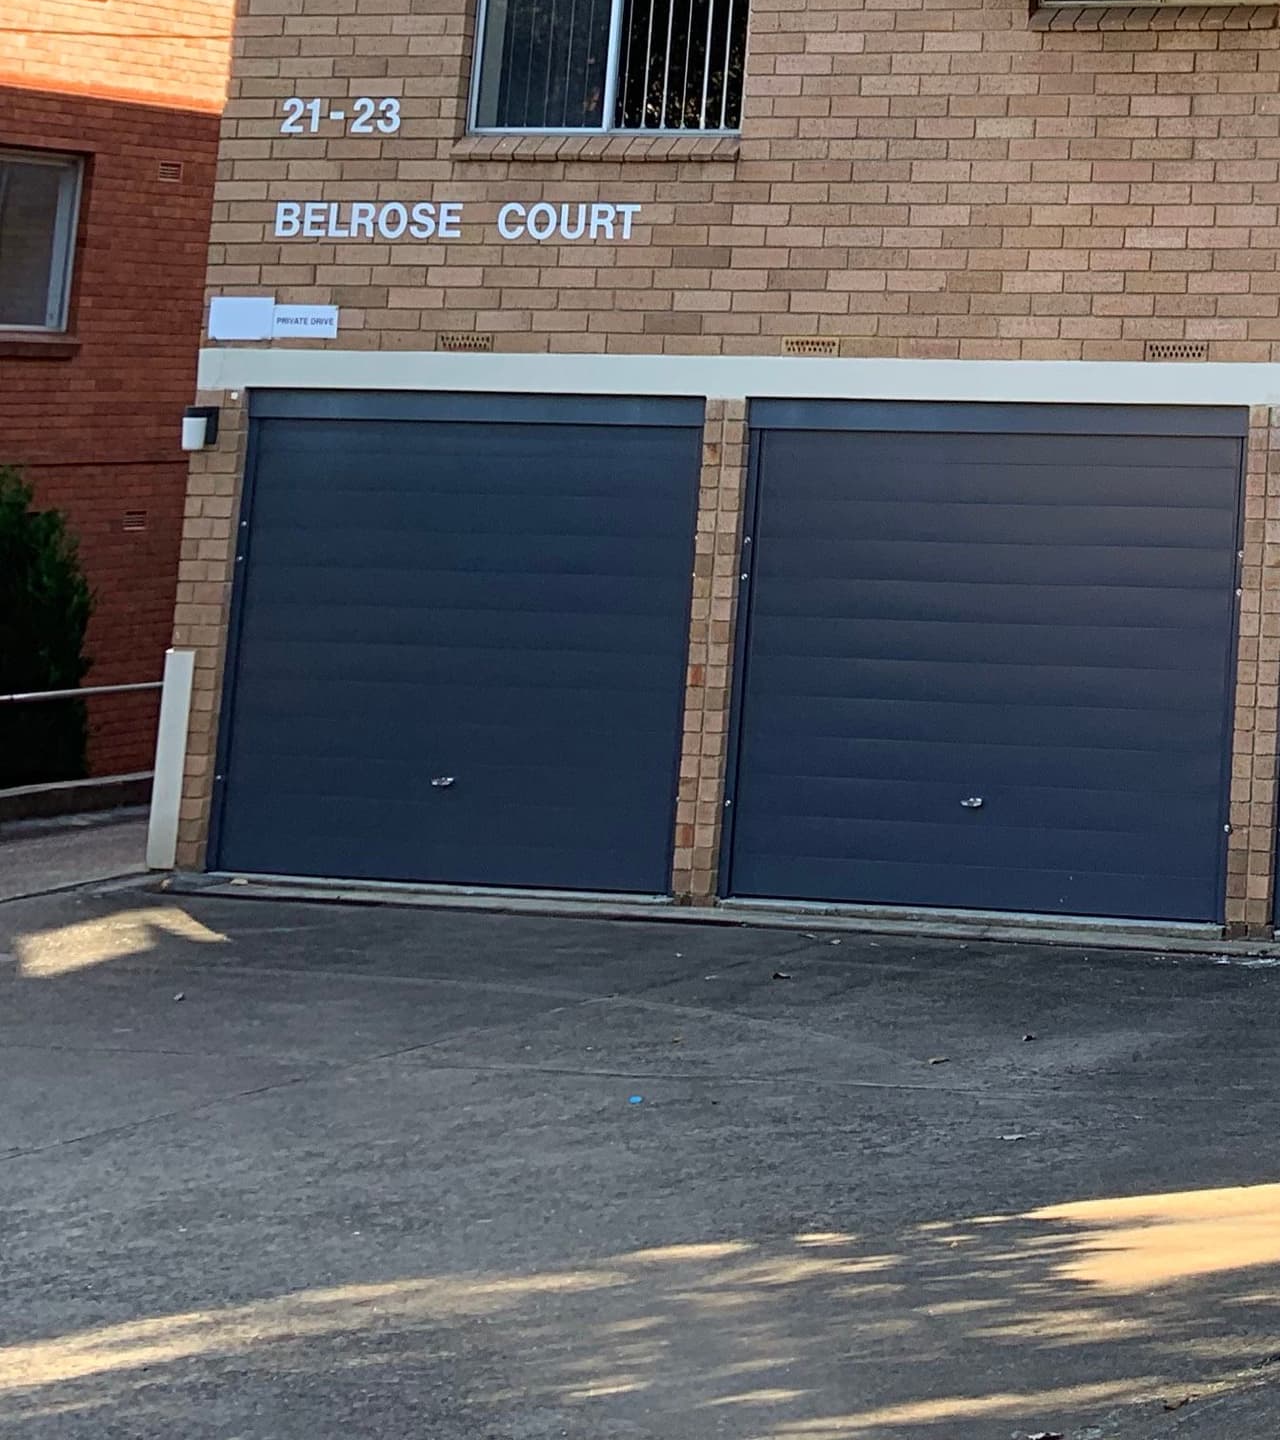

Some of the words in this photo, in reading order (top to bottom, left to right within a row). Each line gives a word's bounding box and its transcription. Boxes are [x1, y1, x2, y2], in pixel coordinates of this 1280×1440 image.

[280, 97, 401, 134] 21-23
[274, 201, 464, 239] BELROSE
[497, 202, 642, 241] COURT
[276, 317, 308, 326] PRIVATE
[310, 317, 334, 326] DRIVE
